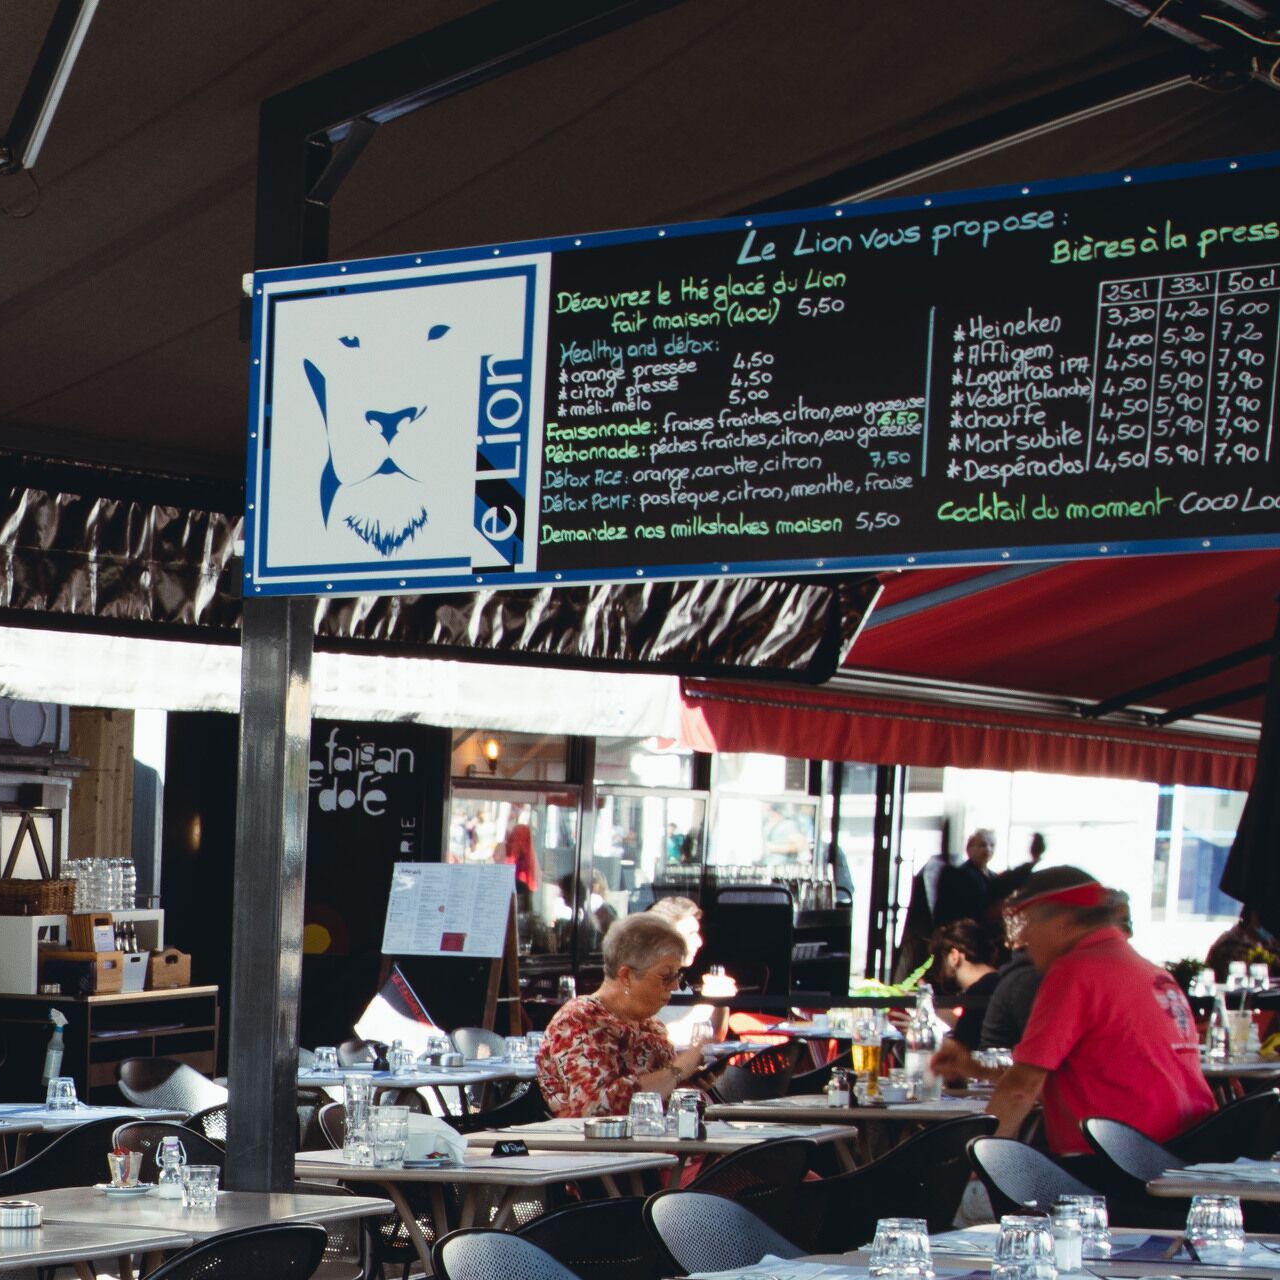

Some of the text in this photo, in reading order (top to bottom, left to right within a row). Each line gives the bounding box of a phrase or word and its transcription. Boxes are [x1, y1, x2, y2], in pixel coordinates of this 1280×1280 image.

[736, 230, 777, 265] Le
[793, 228, 853, 257] Lion
[1050, 235, 1136, 264] Bières
[1140, 226, 1159, 252] à
[1165, 219, 1188, 251] la
[555, 268, 846, 314] Découvrez le thé glacé du Lion
[1105, 282, 1148, 301] 25cl
[1169, 276, 1209, 295] 33cl
[611, 310, 648, 334] fait
[652, 311, 720, 330] maison
[797, 298, 845, 318] 5,50
[1105, 306, 1155, 327] 3,30
[1165, 301, 1209, 321] 4,20
[1219, 298, 1270, 316] 6,00
[969, 307, 1061, 339] Heineken
[1221, 322, 1263, 344] 7,20
[1107, 332, 1154, 350] 4,00
[1162, 326, 1205, 345] 5,20
[559, 337, 624, 370] Healthy
[627, 337, 657, 357] and
[968, 340, 1054, 373] Affligem
[1104, 353, 1153, 371] 4,50
[1160, 348, 1206, 369] 5,90
[1218, 348, 1265, 371] 7,90
[571, 351, 775, 390] orange pressée 4,50
[570, 372, 773, 402] citron pressé 4,50
[1102, 376, 1148, 396] 4,50
[1158, 371, 1204, 394] 5,90
[1216, 371, 1263, 394] 7,90
[728, 389, 770, 405] 5,00
[1155, 393, 1203, 417] 5,90
[1216, 395, 1261, 417] 7,90
[475, 354, 524, 481] Lion
[1100, 399, 1149, 421] 4,50
[662, 411, 715, 433] fraises
[1153, 415, 1204, 438] 5,90
[1215, 416, 1260, 440] 7,90
[1096, 424, 1145, 445] 4,50
[649, 436, 698, 464] pêches
[1154, 444, 1199, 466] 5,90
[1214, 442, 1260, 466] 7,90
[542, 468, 590, 489] Détox
[869, 451, 911, 468] 7,50
[963, 452, 1085, 488] Despérados
[1094, 451, 1146, 474] 4,50
[542, 492, 588, 513] Détox
[937, 491, 1026, 522] Cocktail
[1032, 493, 1060, 520] du
[1065, 487, 1173, 519] moment
[540, 511, 901, 545] Demandez nos milkshakes maison 5,50
[325, 727, 415, 775] faisan
[318, 771, 387, 817] doré
